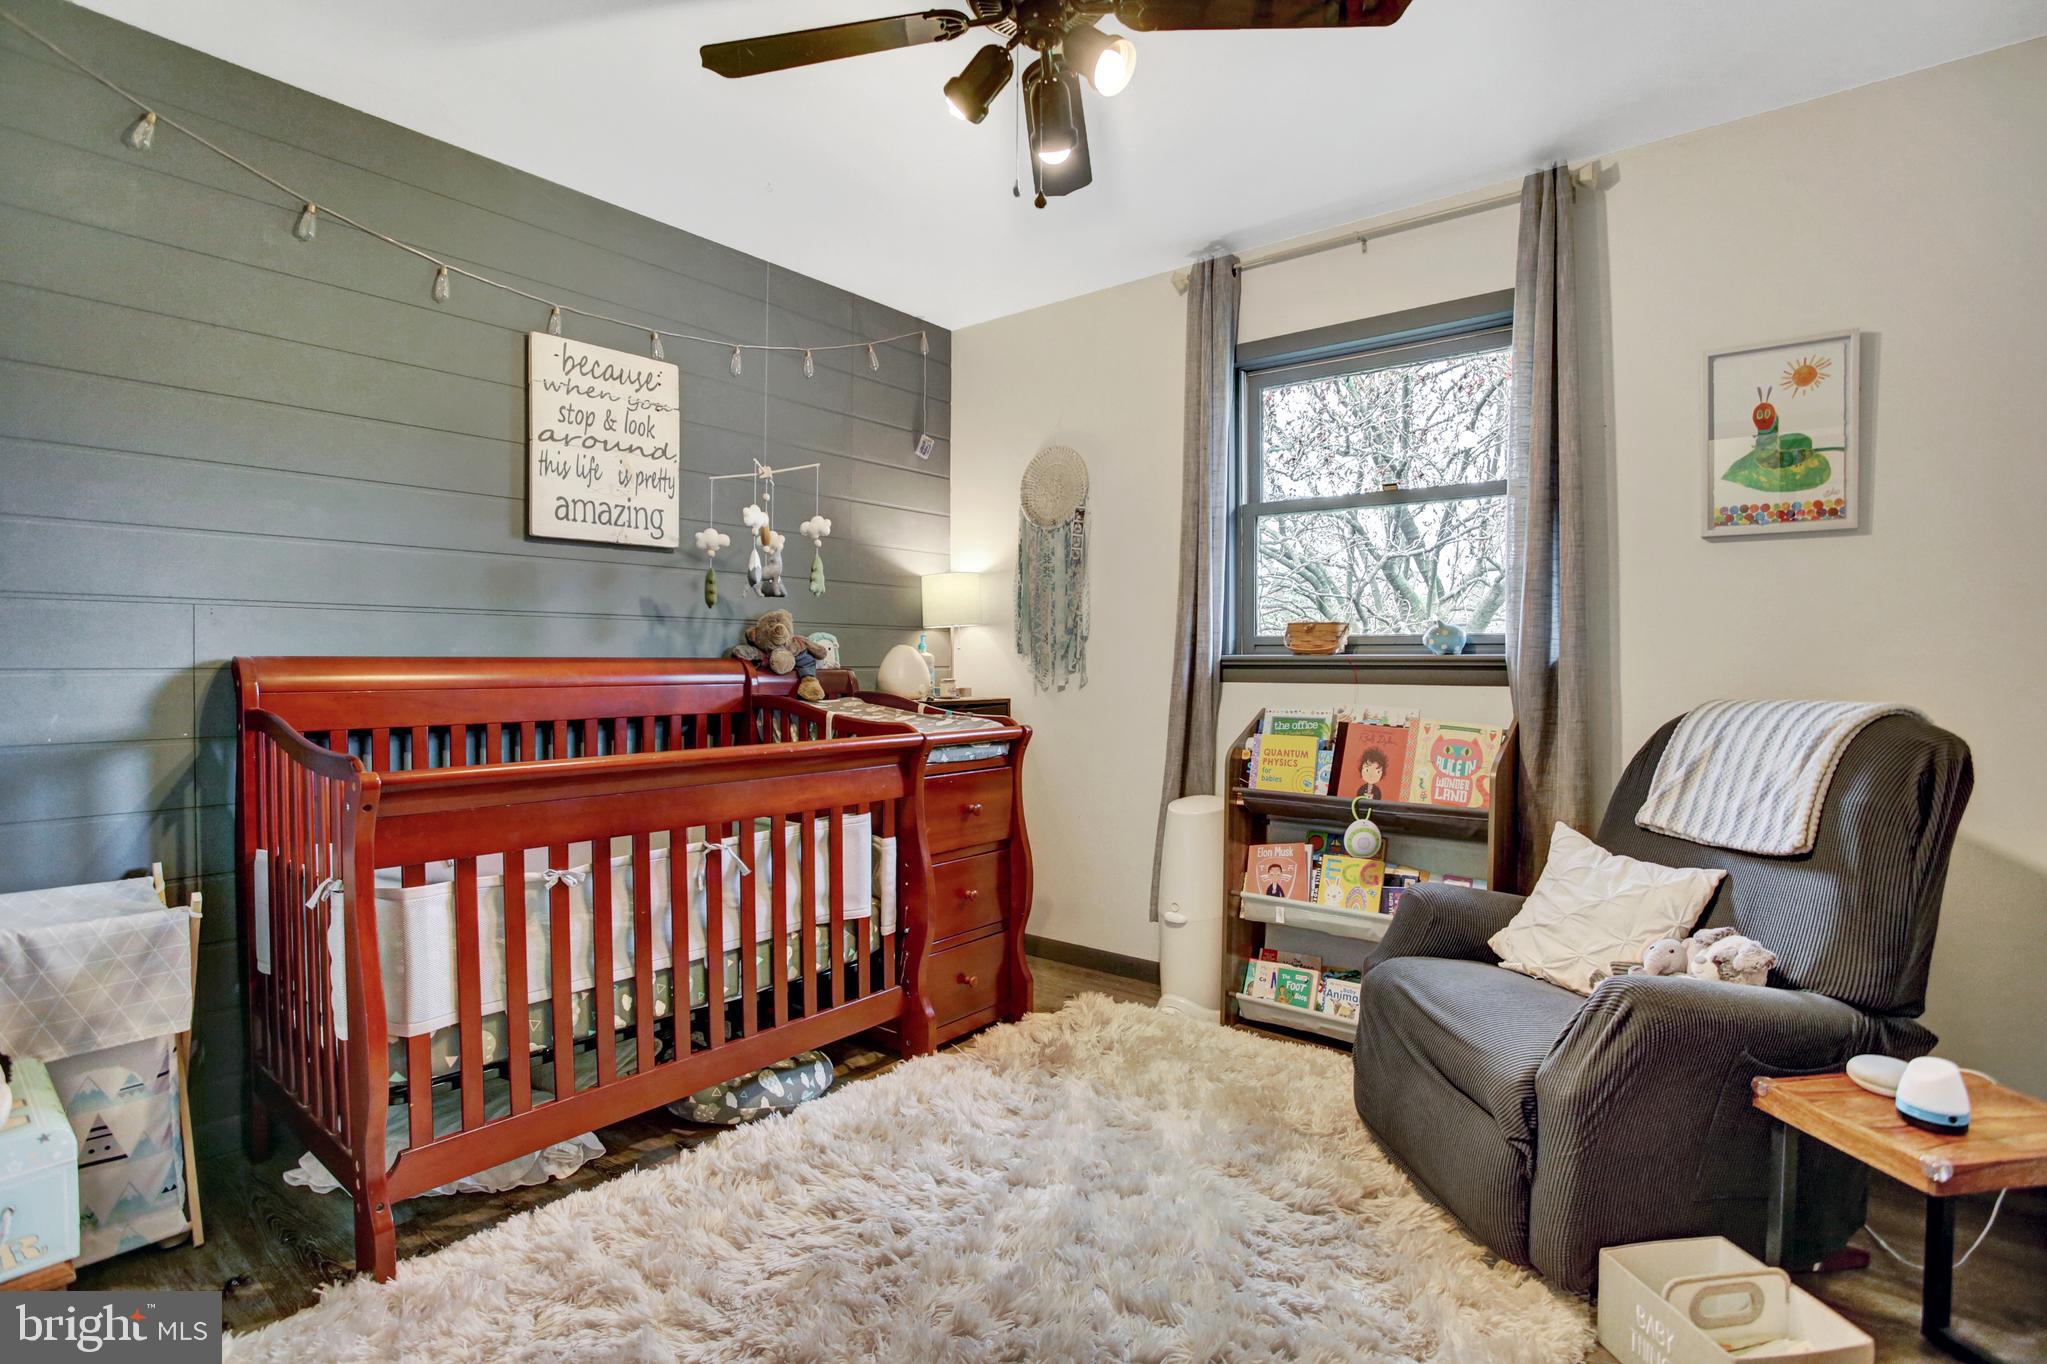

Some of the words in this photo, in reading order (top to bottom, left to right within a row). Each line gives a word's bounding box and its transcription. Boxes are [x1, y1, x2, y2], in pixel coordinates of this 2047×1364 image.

[562, 342, 659, 392] because
[543, 378, 620, 402] when
[627, 396, 679, 411] you
[558, 403, 595, 435] stop
[604, 409, 617, 431] &
[624, 411, 655, 439] look
[538, 429, 677, 460] around
[539, 450, 571, 479] this
[576, 454, 603, 488] life
[619, 460, 632, 486] is
[635, 467, 675, 499] pretty
[555, 496, 664, 539] amazing
[1274, 721, 1290, 730] the
[1292, 721, 1318, 729] office
[1262, 757, 1298, 768] PHYSICS
[1264, 748, 1309, 759] QUANTUM
[1436, 755, 1462, 777] ALICE
[1464, 759, 1477, 776] IN
[1261, 775, 1283, 783] babies
[1435, 776, 1470, 791] WONDER
[1434, 787, 1468, 803] LAND
[1257, 847, 1273, 858] Elon
[1274, 846, 1294, 857] Musk
[1325, 858, 1380, 886] EGG
[1286, 980, 1308, 993] FOOT
[1326, 989, 1360, 1003] Anima
[1636, 1304, 1675, 1354] BABY
[1630, 1327, 1668, 1364] THIN
